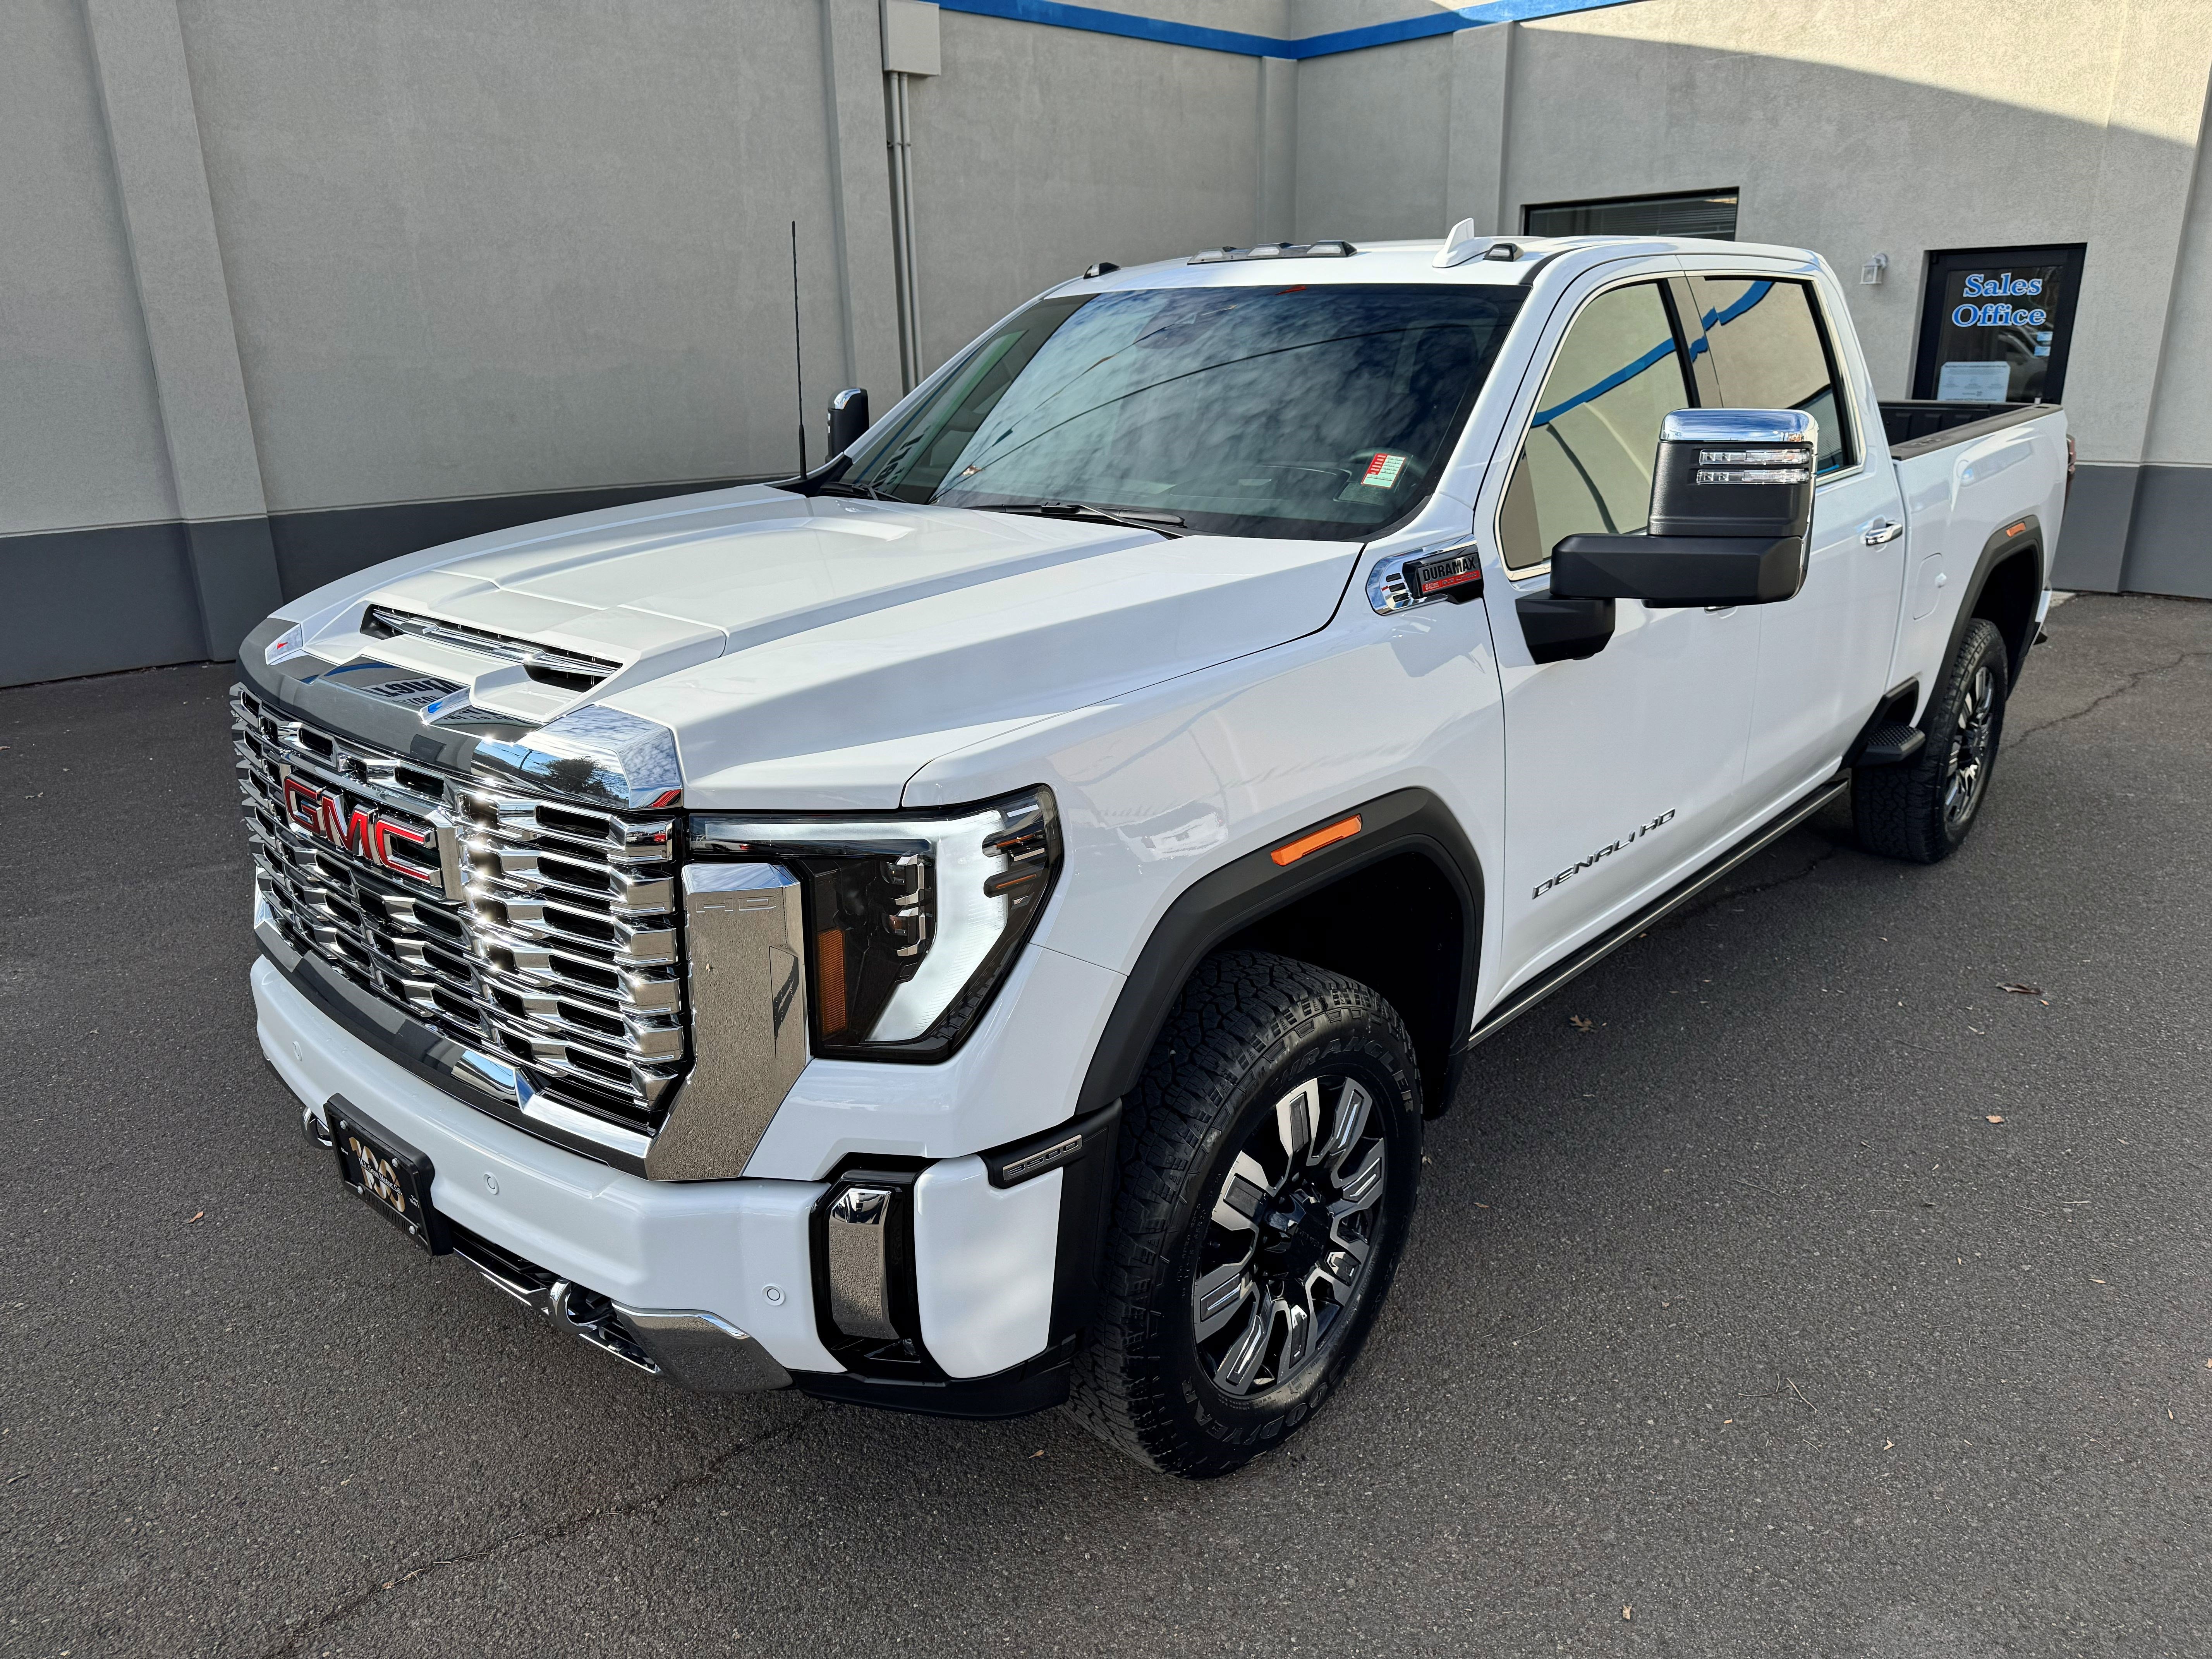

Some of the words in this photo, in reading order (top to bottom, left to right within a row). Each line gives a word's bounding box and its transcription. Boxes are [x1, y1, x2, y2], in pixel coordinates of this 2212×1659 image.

[1963, 272, 2043, 297] Sales
[1952, 303, 2046, 327] Office
[1422, 557, 1476, 581] DURAMAX
[284, 773, 437, 884] GMC
[1532, 830, 1635, 899] DENALI
[1639, 807, 1676, 837] HD
[696, 896, 776, 913] HD
[1270, 1036, 1414, 1112] WRANGLER
[349, 1137, 405, 1212] 100
[1008, 1140, 1079, 1176] 3500
[1182, 1355, 1347, 1446] GOODYEAR
